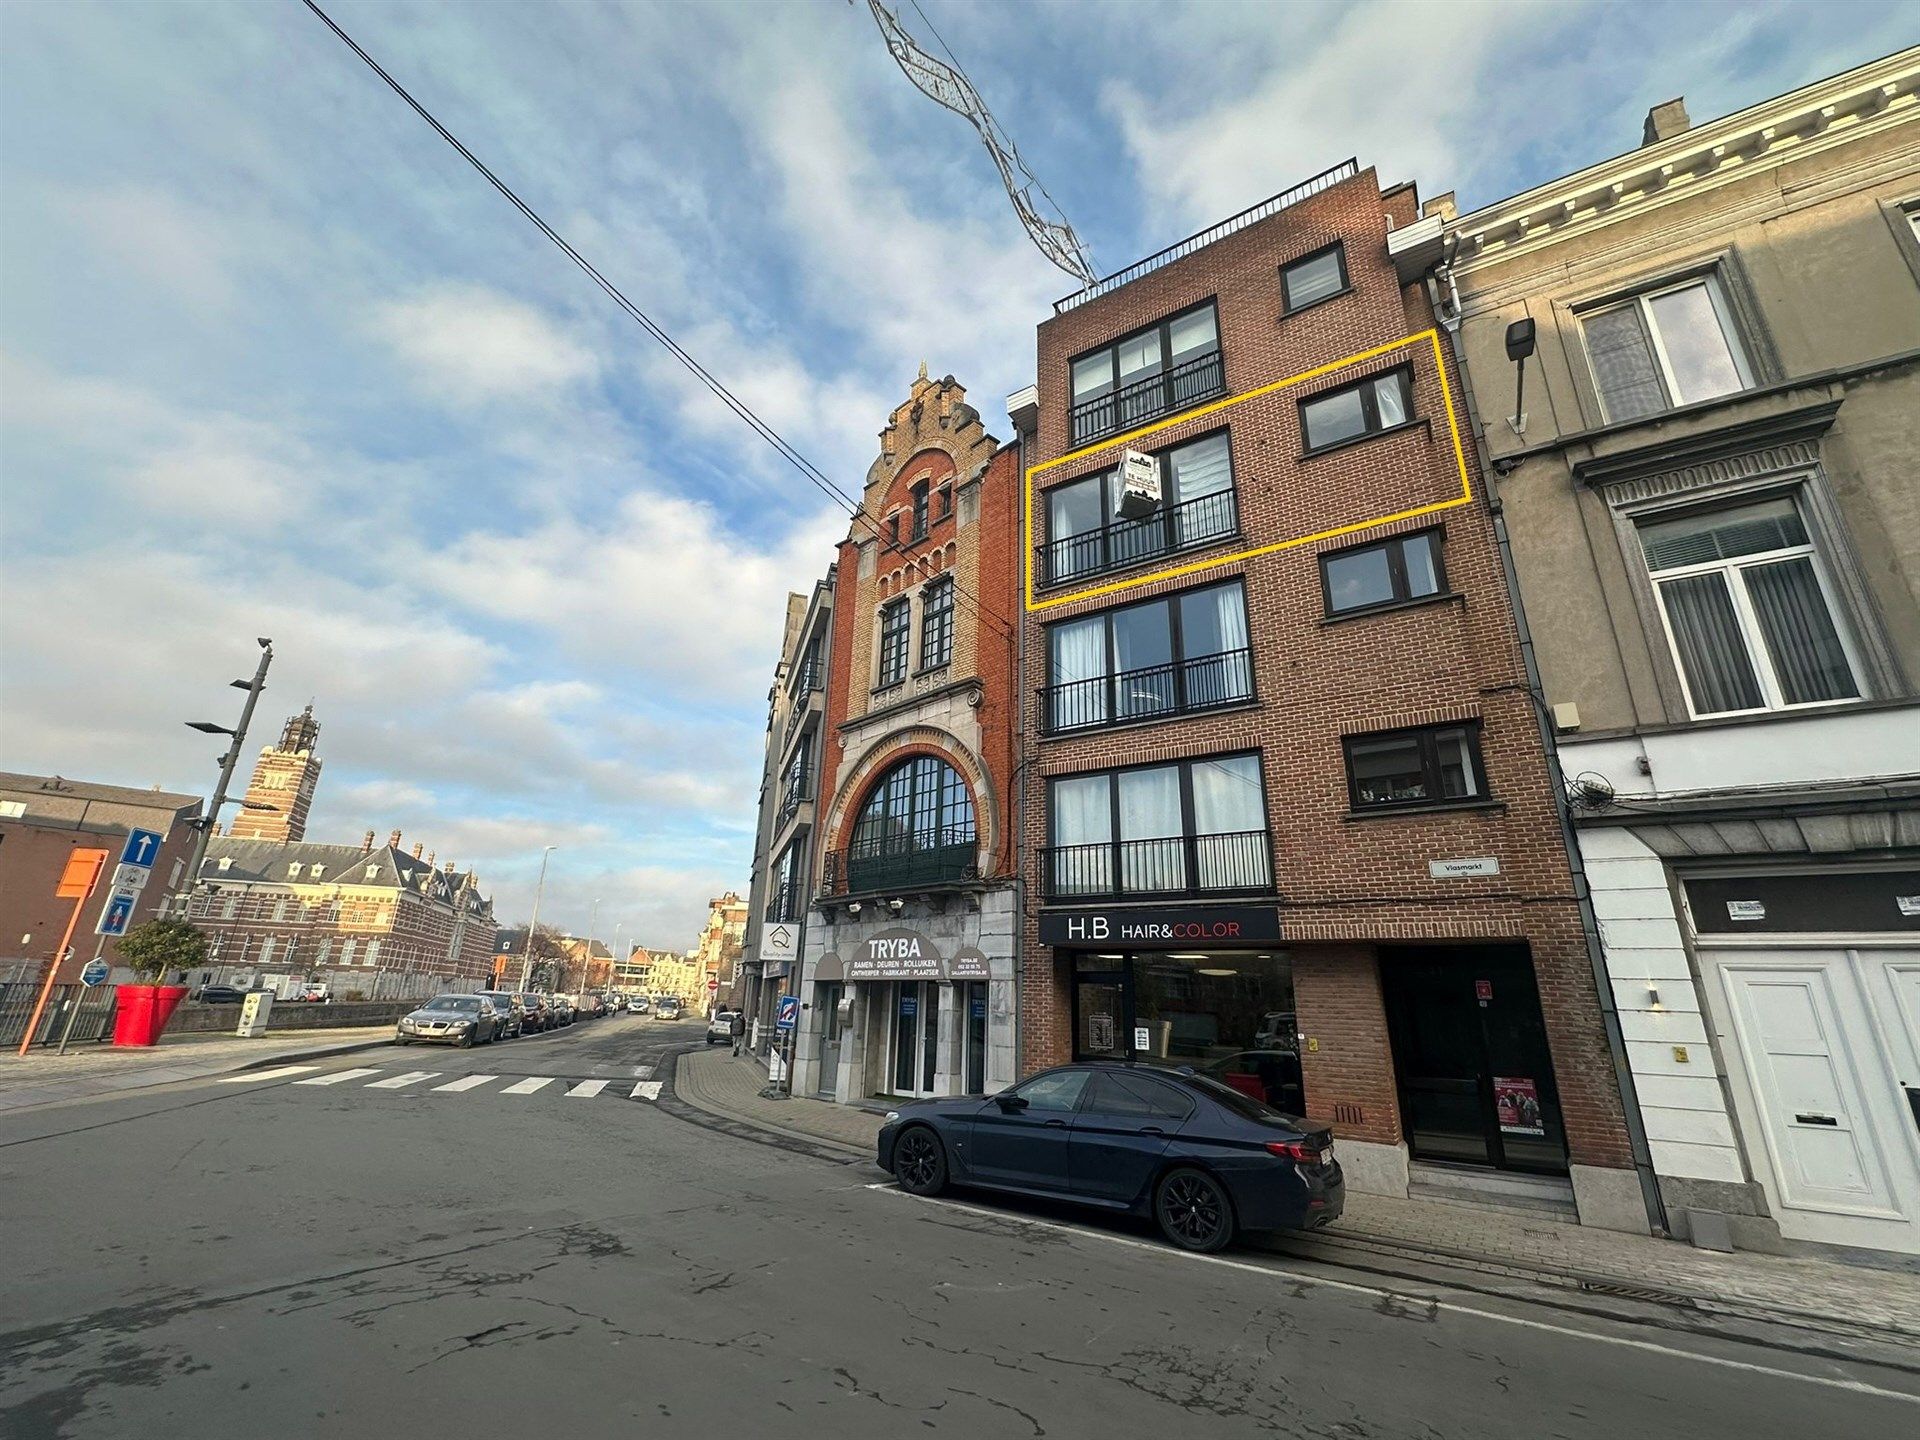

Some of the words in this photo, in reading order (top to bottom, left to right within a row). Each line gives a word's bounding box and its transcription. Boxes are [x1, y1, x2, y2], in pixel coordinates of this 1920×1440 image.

[1068, 916, 1110, 940] H.B
[868, 937, 922, 959] TRYBA
[853, 960, 874, 969] RAMEN
[876, 960, 900, 969] DEUREN
[903, 959, 937, 968] ROLLUIKEN
[851, 969, 880, 977] ONTWERPER
[882, 968, 910, 976] FABRIKANT
[913, 968, 939, 976] PLAATSER
